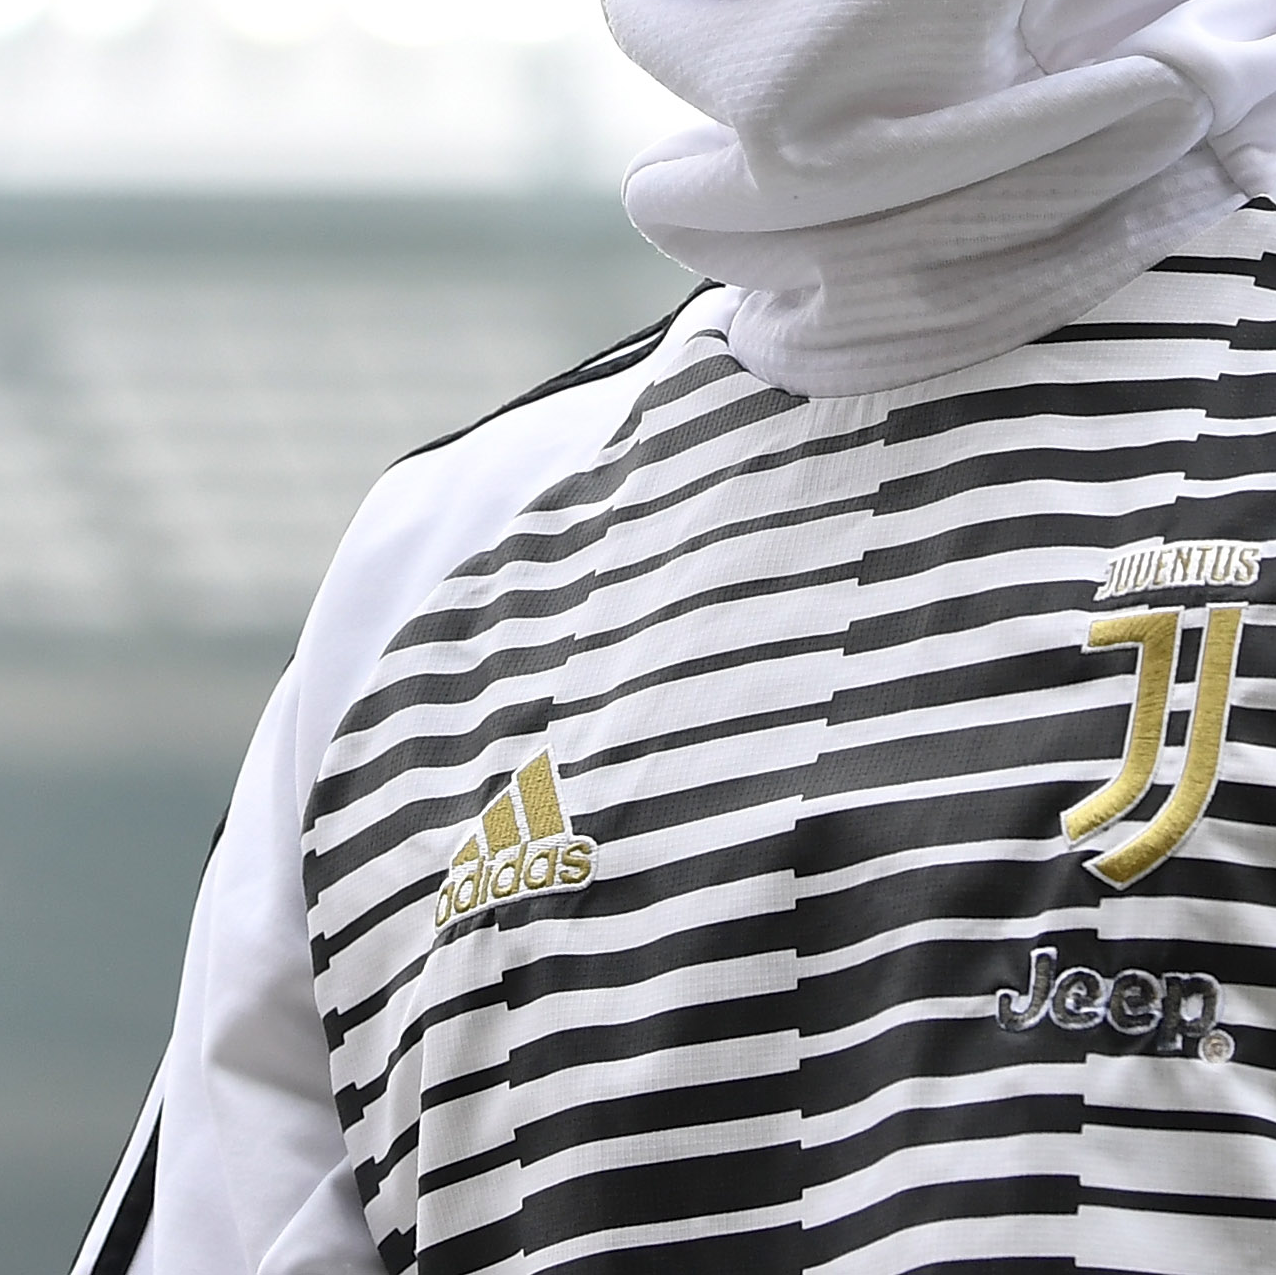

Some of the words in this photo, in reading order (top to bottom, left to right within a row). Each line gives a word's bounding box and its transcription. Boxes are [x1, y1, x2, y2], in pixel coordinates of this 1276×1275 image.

[1096, 544, 1261, 596] JUVENTUS
[435, 839, 593, 928] adidas
[996, 948, 1222, 1051] Jeep
